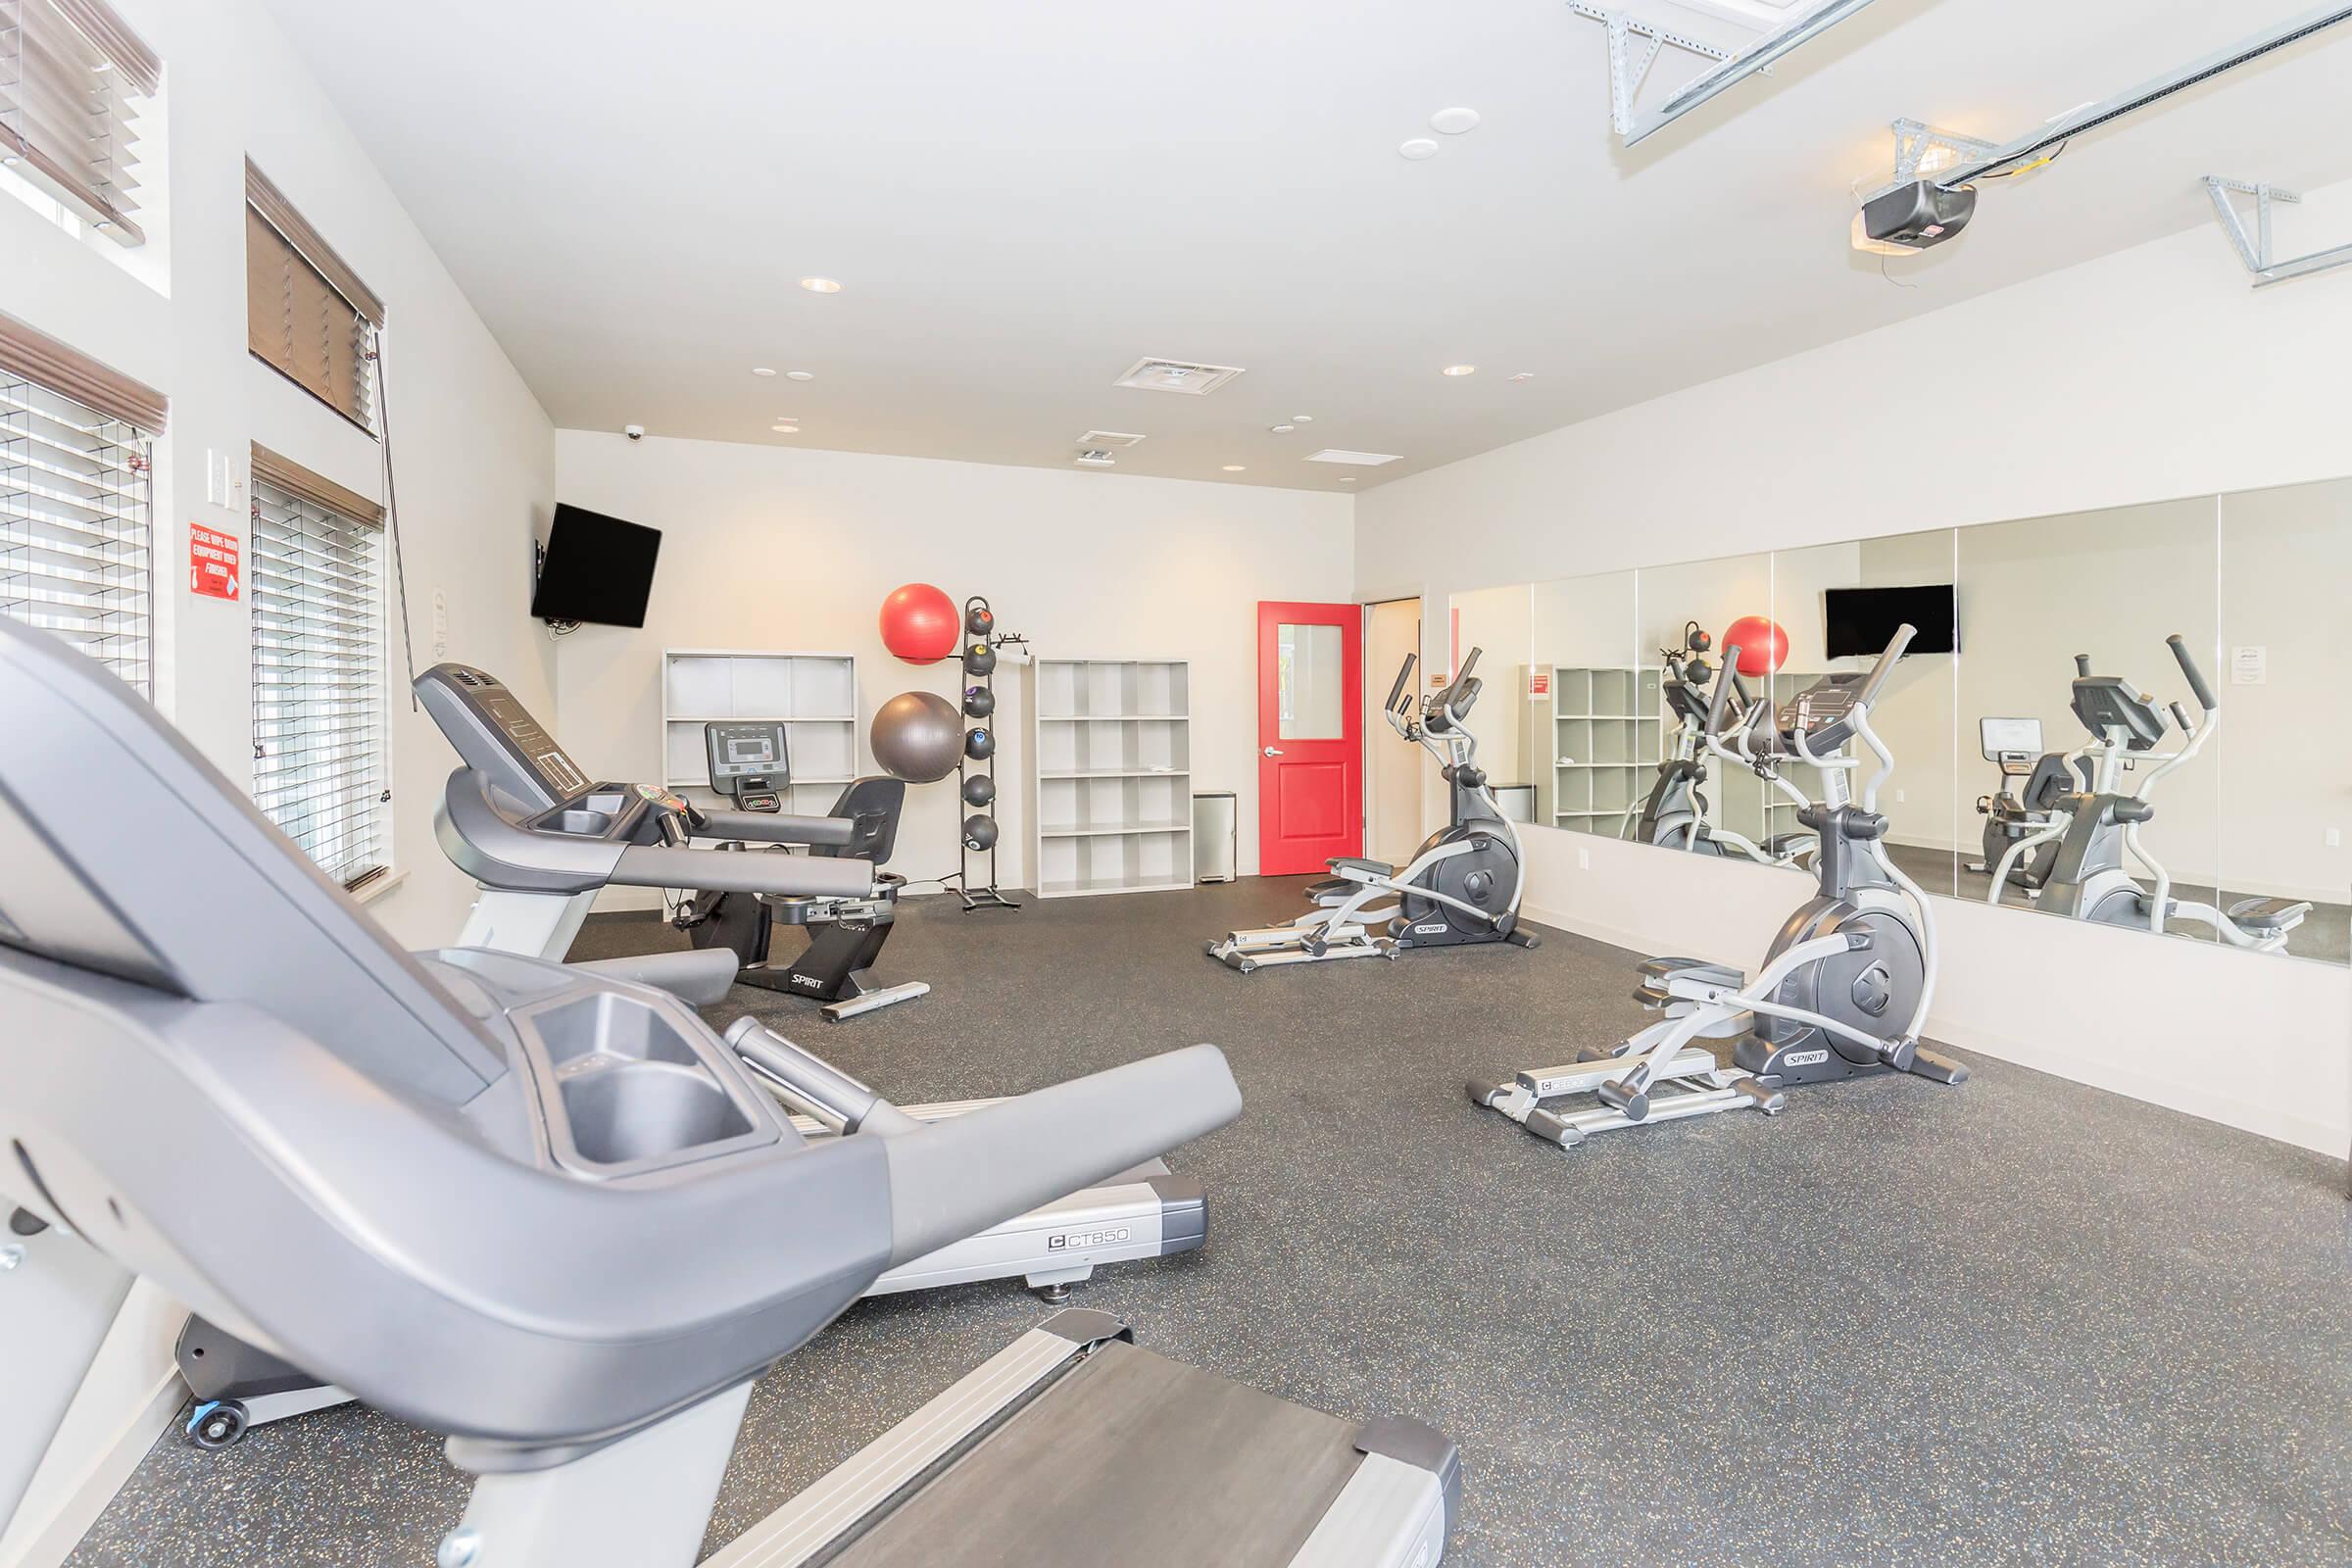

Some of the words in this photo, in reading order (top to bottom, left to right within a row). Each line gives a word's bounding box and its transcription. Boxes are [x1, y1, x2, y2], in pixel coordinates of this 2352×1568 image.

[191, 528, 211, 543] PLEASE
[791, 973, 824, 989] SPIRIT
[1789, 1052, 1825, 1064] SPIRIT
[1068, 1228, 1129, 1248] CT850
